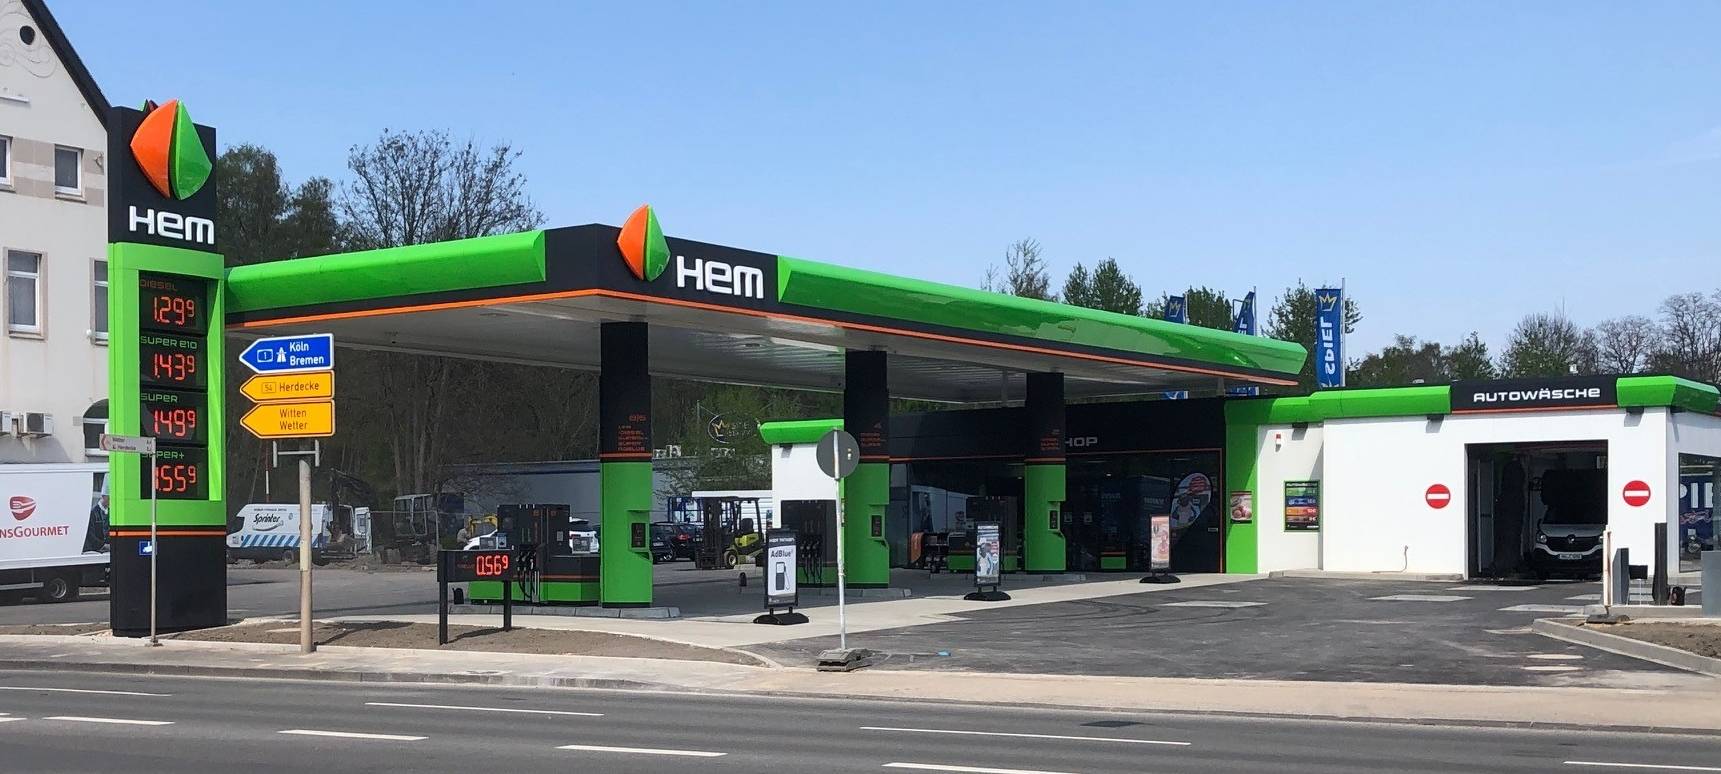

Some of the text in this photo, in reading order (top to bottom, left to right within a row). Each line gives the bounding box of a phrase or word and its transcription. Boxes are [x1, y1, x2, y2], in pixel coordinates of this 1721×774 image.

[129, 205, 215, 245] HEM
[676, 255, 764, 299] HEM
[140, 279, 178, 291] DIESEL
[140, 336, 178, 348] SUPER
[289, 341, 309, 352] Köln
[263, 352, 268, 360] 1
[289, 355, 324, 366] Bremen
[279, 381, 320, 392] Herdecke
[140, 393, 178, 404] SUPER
[1473, 387, 1601, 402] AUTOWÄSCHE
[279, 408, 307, 418] Witten
[279, 420, 308, 430] Wetter
[253, 513, 281, 525] Sprinter
[770, 549, 792, 558] AdBlue
